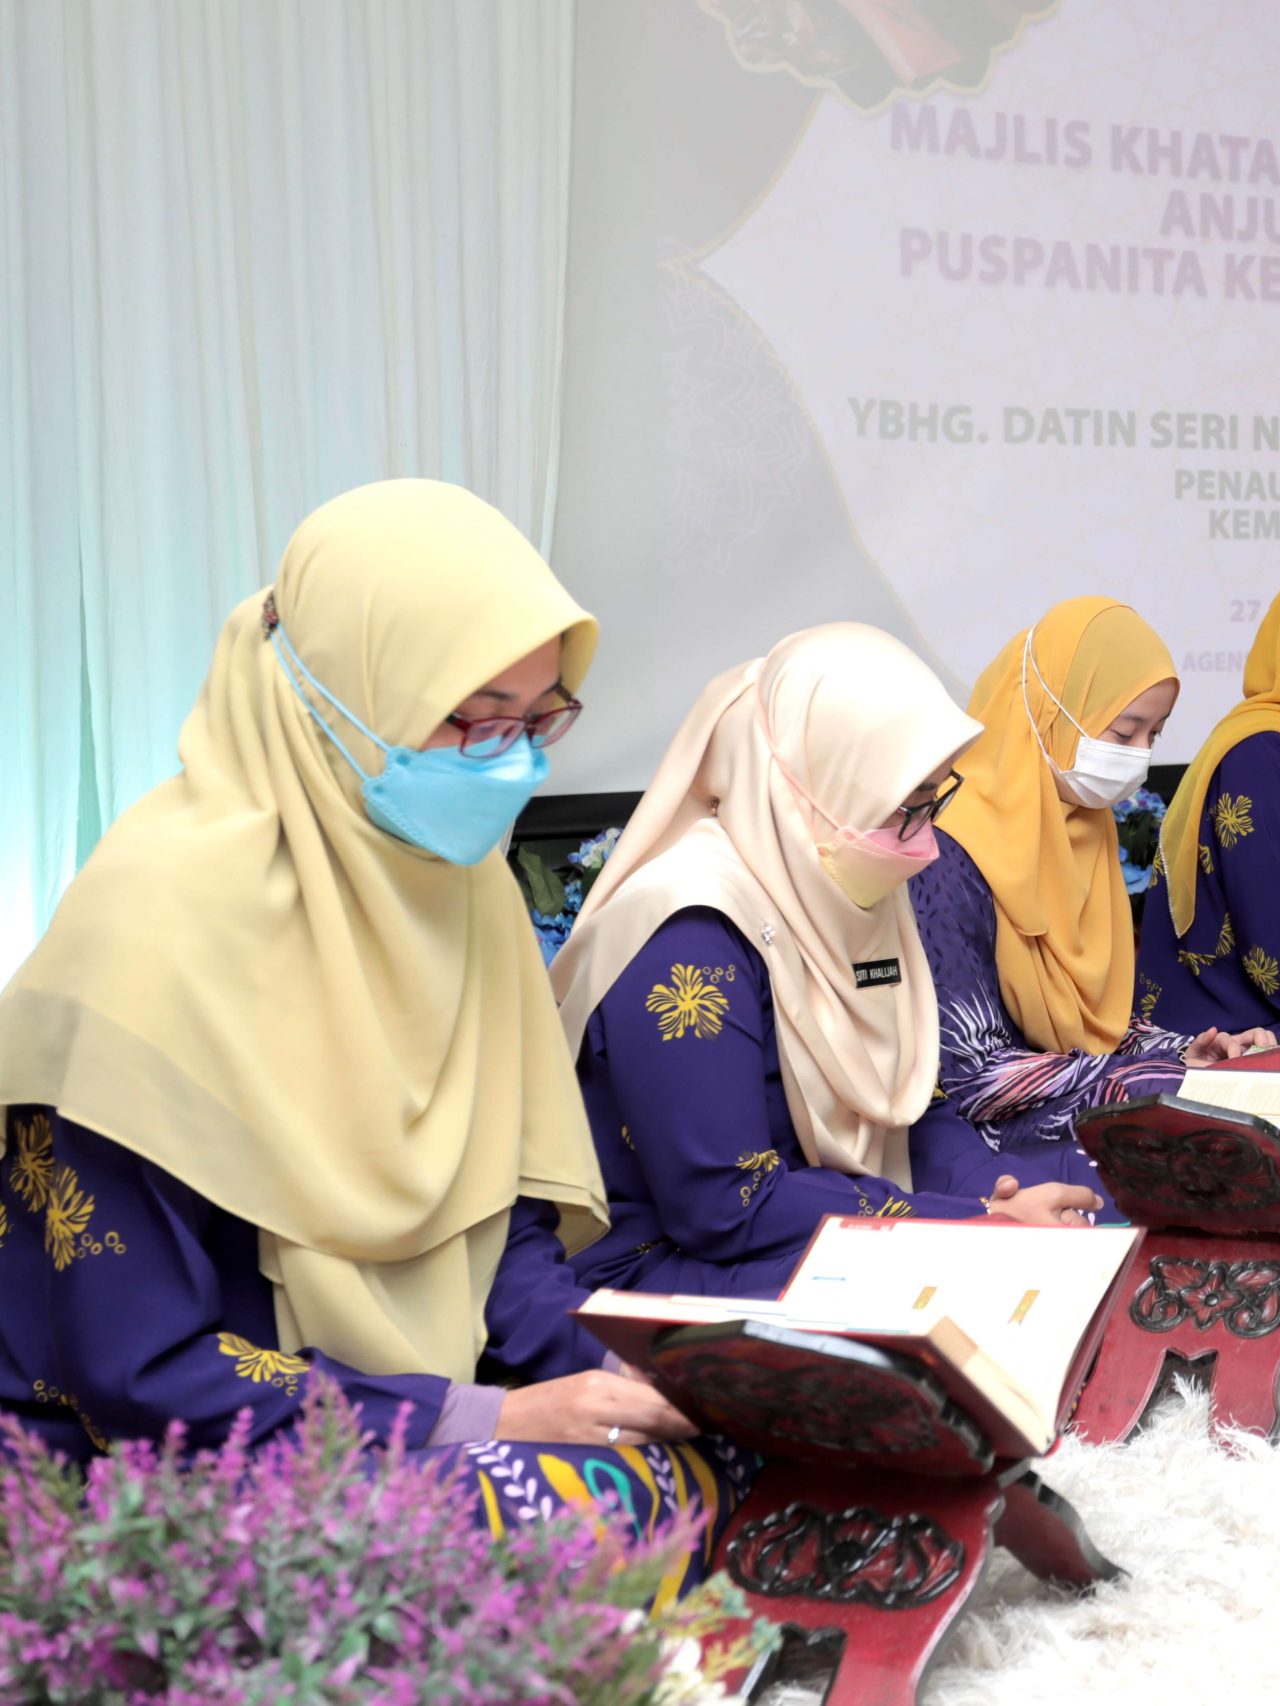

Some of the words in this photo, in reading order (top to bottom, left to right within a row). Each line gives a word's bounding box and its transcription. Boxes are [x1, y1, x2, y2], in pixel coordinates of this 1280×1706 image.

[890, 101, 1092, 169] MAJLIS
[900, 228, 1207, 298] PUSPANITA
[848, 398, 988, 443] YBHG.
[1004, 407, 1136, 447] DATIN
[1150, 412, 1238, 450] SERI
[1229, 599, 1262, 624] 27
[1181, 650, 1249, 673] AGEN
